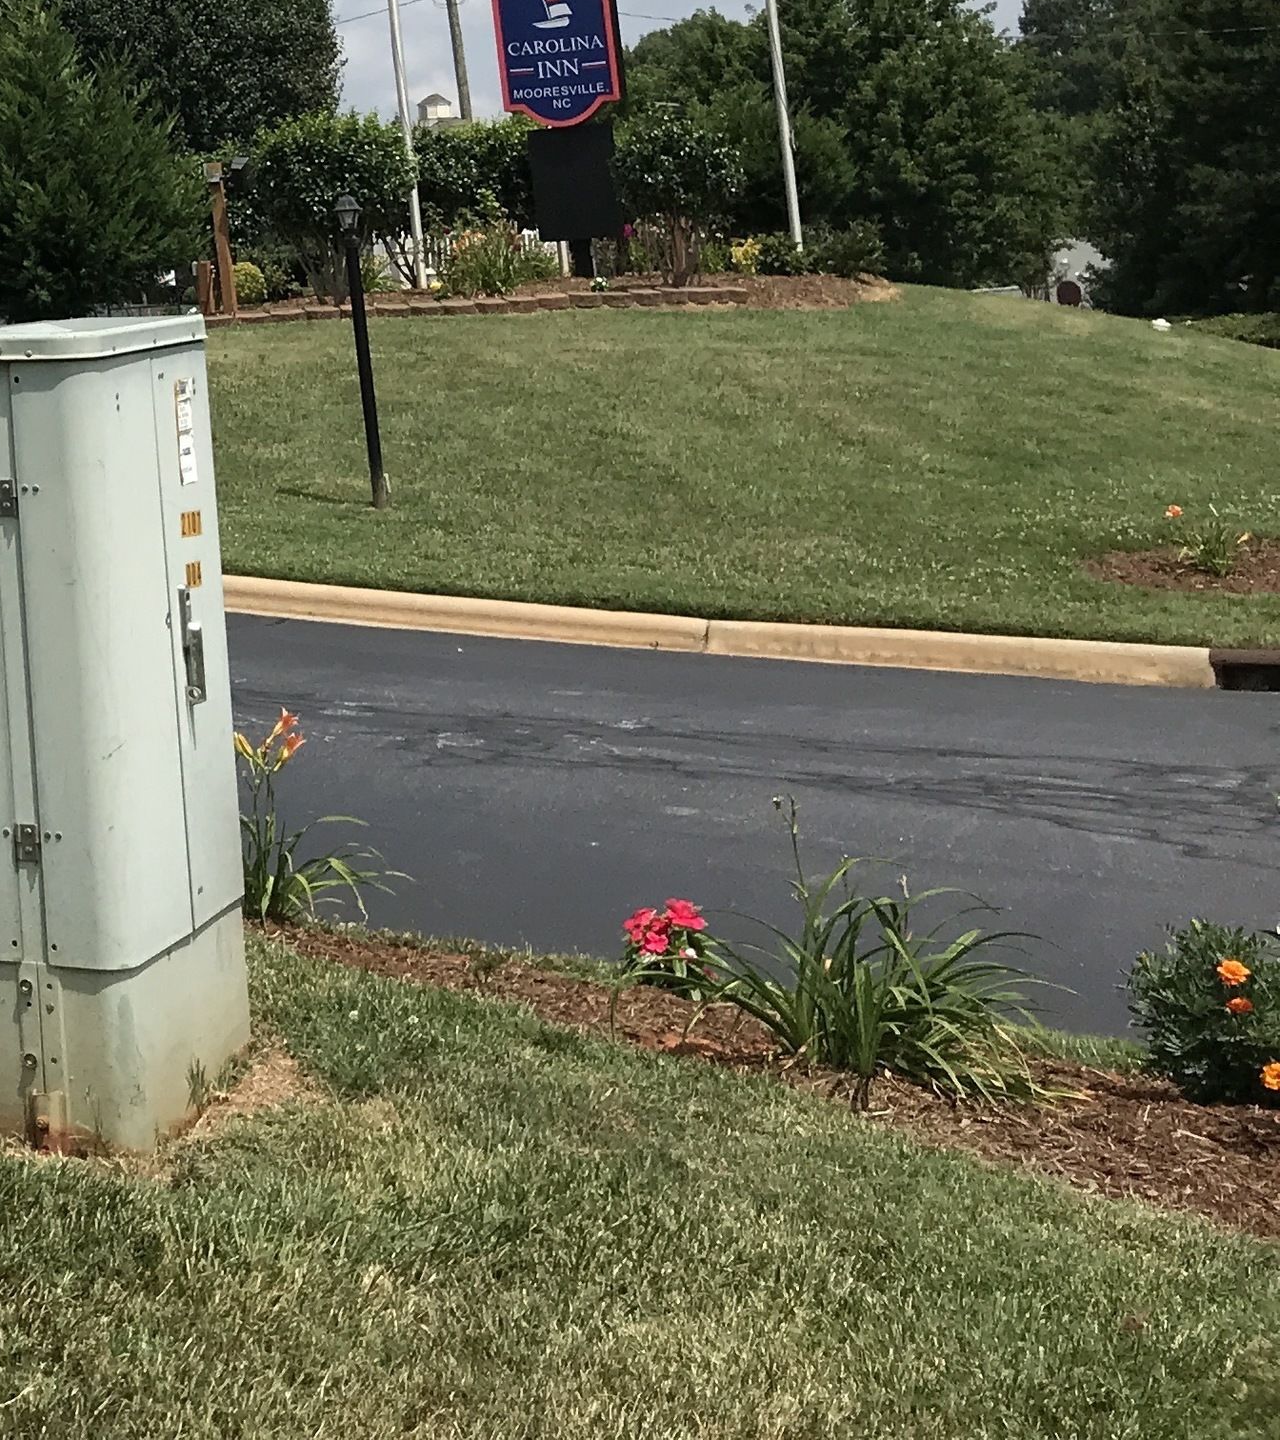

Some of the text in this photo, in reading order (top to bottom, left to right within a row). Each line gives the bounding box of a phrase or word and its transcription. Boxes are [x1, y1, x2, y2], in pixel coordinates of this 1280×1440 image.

[507, 35, 604, 57] CAROLINA
[537, 58, 579, 79] INN
[553, 98, 571, 109] NC
